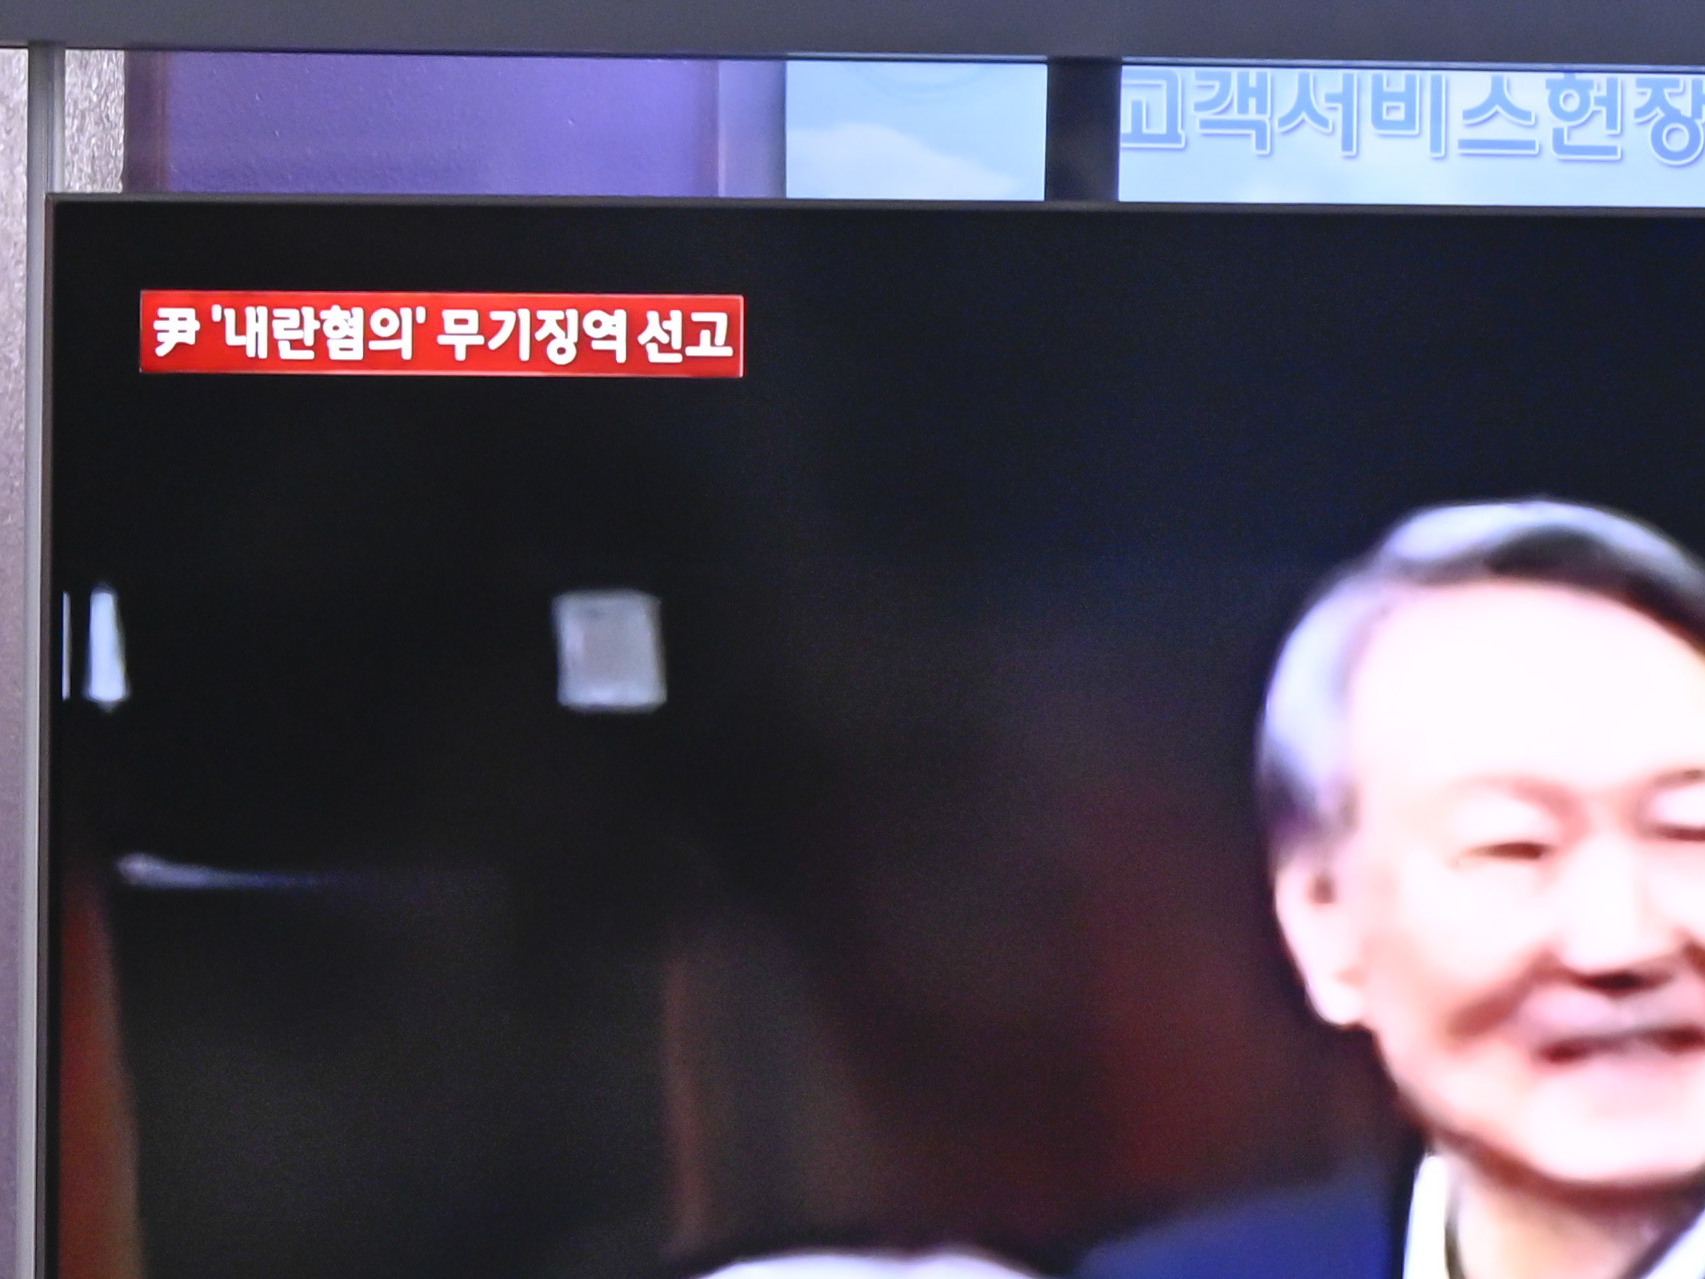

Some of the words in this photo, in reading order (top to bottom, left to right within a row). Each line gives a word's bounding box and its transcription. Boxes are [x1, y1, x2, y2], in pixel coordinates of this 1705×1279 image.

[153, 305, 201, 358] 尹
[211, 303, 428, 361] '내란혐의'
[437, 308, 627, 366] 무기징역
[637, 310, 734, 364] 선고
